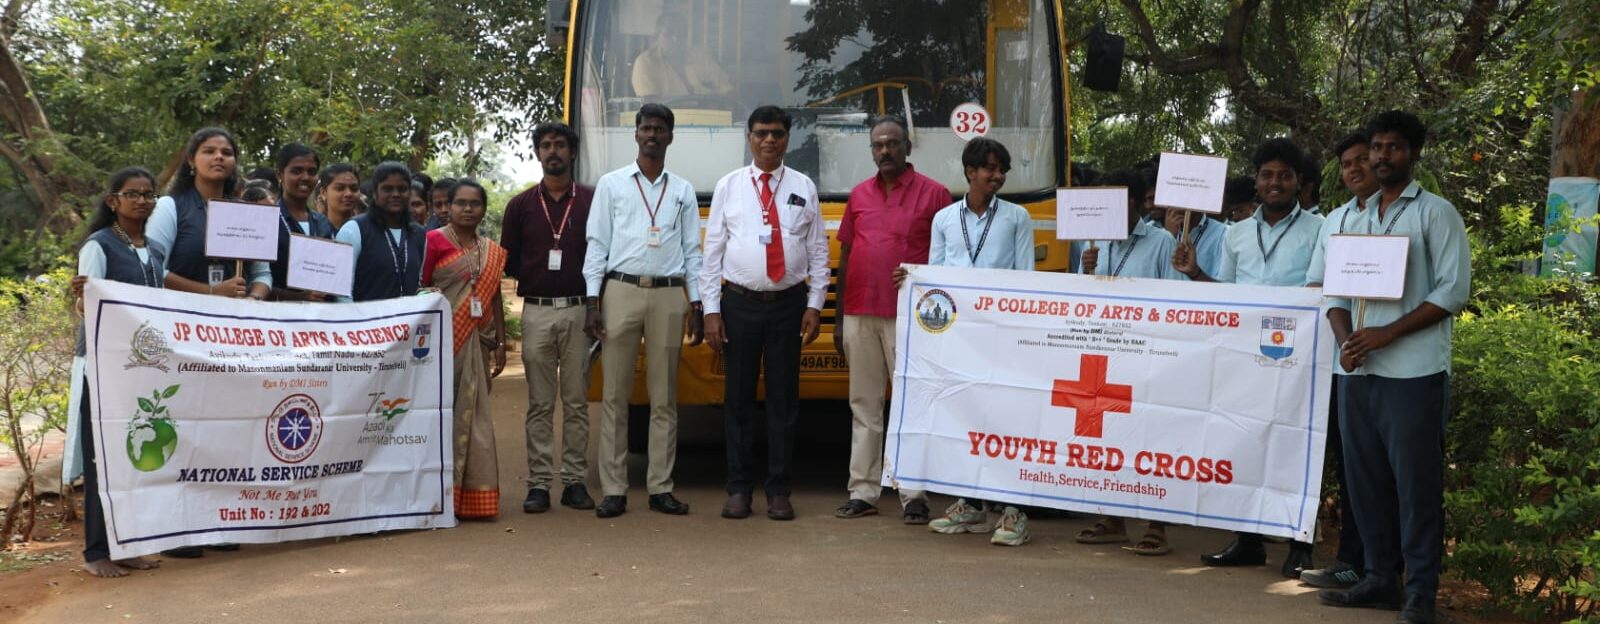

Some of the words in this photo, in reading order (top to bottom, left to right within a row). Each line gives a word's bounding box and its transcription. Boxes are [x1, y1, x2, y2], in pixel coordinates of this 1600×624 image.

[956, 111, 986, 134] 32
[975, 297, 993, 310] JP
[998, 298, 1069, 316] COLLEGE
[1074, 303, 1096, 317] OF
[1100, 304, 1143, 320] ARTS
[1148, 307, 1160, 321] &
[1165, 309, 1239, 328] SCIENCE
[173, 322, 191, 341] JP
[196, 324, 265, 346] COLLEGE
[292, 331, 330, 347] ARTS
[332, 332, 346, 346] &
[347, 323, 410, 346] SCIENCE
[334, 350, 355, 358] Nadu
[801, 356, 849, 368] 49AF98
[177, 362, 226, 373] (Affiliated
[228, 363, 237, 372] to
[336, 362, 372, 374] University
[968, 431, 1057, 465] YOUTH
[1066, 442, 1124, 471] RED
[1134, 450, 1233, 484] CROSS
[176, 467, 256, 482] NATIONAL
[261, 466, 319, 481] SERVICE
[321, 460, 363, 477] SCHEME
[238, 489, 260, 500] Not
[262, 490, 282, 500] Me
[303, 488, 318, 500] You
[219, 508, 247, 521] Unit
[251, 508, 266, 520] No
[278, 506, 298, 520] 192
[301, 505, 309, 518] &
[311, 503, 330, 517] 202
